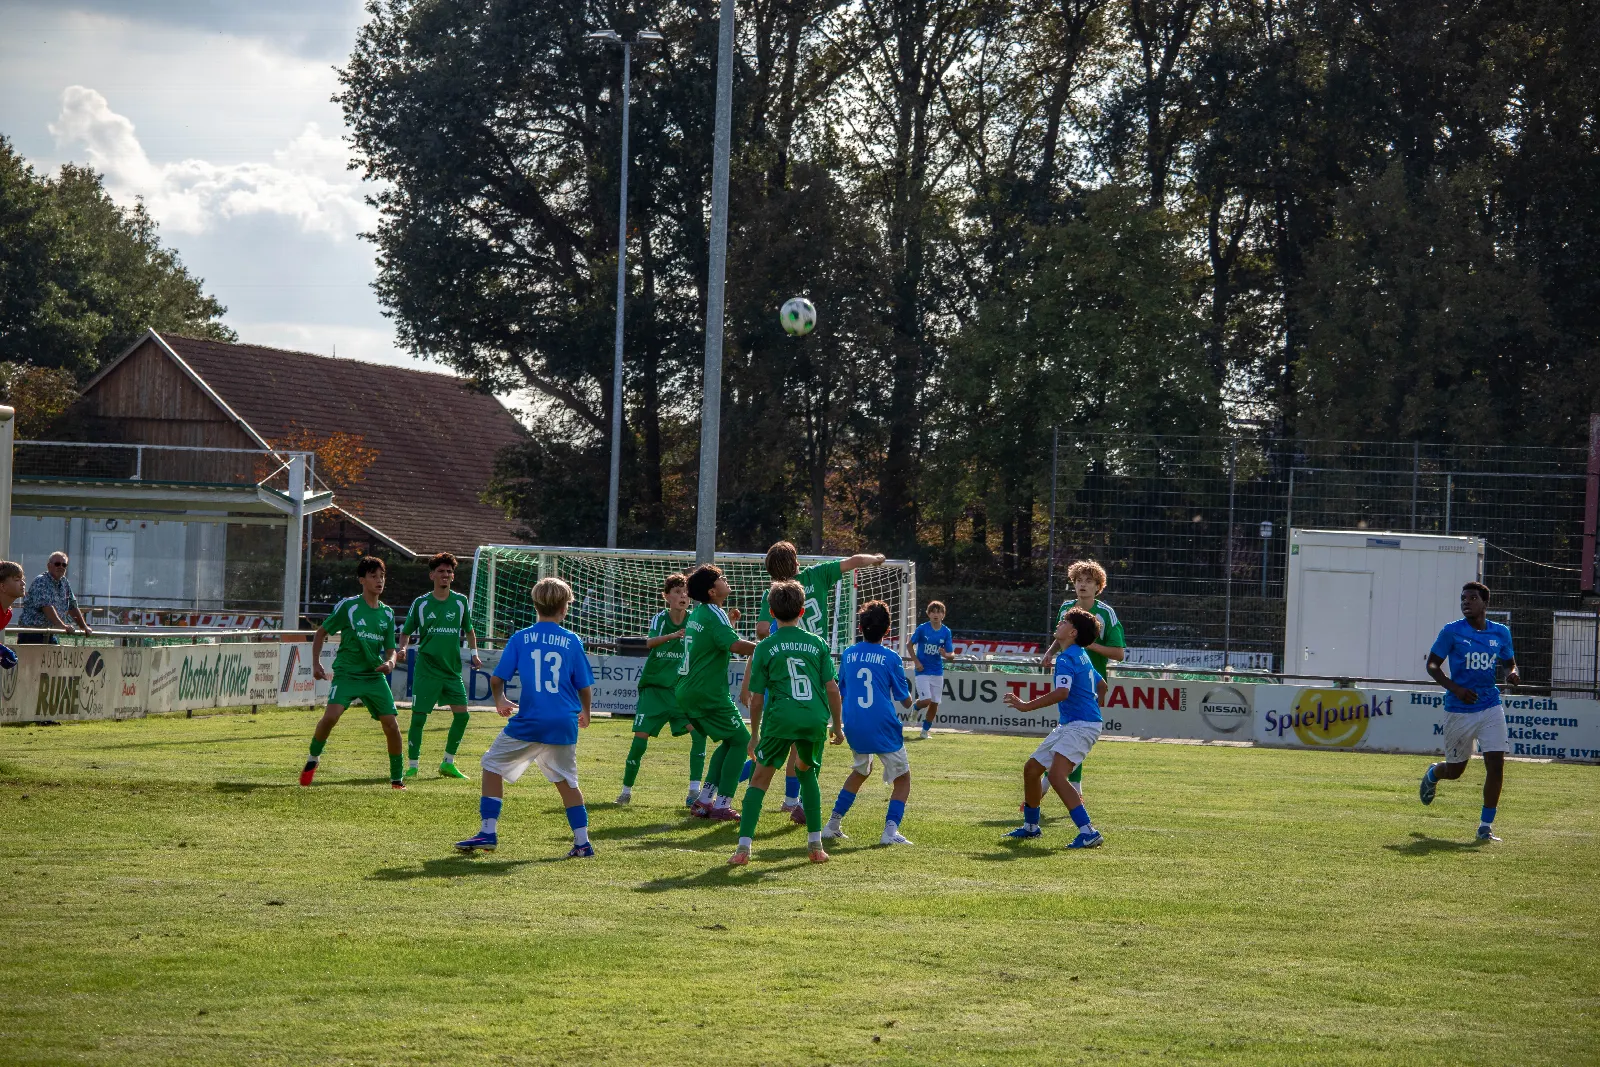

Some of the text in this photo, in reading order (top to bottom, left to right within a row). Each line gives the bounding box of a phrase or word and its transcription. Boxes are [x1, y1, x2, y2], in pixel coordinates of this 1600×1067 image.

[523, 631, 539, 645] BW
[542, 633, 572, 650] LOHNE
[780, 642, 820, 656] BROCKDORF
[41, 651, 84, 669] AUTOHAUS
[846, 652, 887, 666] BW LOHNE
[178, 653, 221, 701] Obsthof
[219, 653, 252, 698] Klöker
[530, 649, 562, 694] 13
[787, 656, 813, 701] 6
[35, 672, 81, 716] RUHE
[121, 682, 136, 696] Audi
[612, 688, 637, 698] 49393
[856, 667, 875, 709] 3
[1180, 687, 1188, 712] GmbH
[1203, 705, 1247, 714] NISSAN
[1264, 694, 1394, 737] Spielpunkt
[1504, 714, 1579, 728] ungeerun
[1513, 742, 1567, 760] Riding
